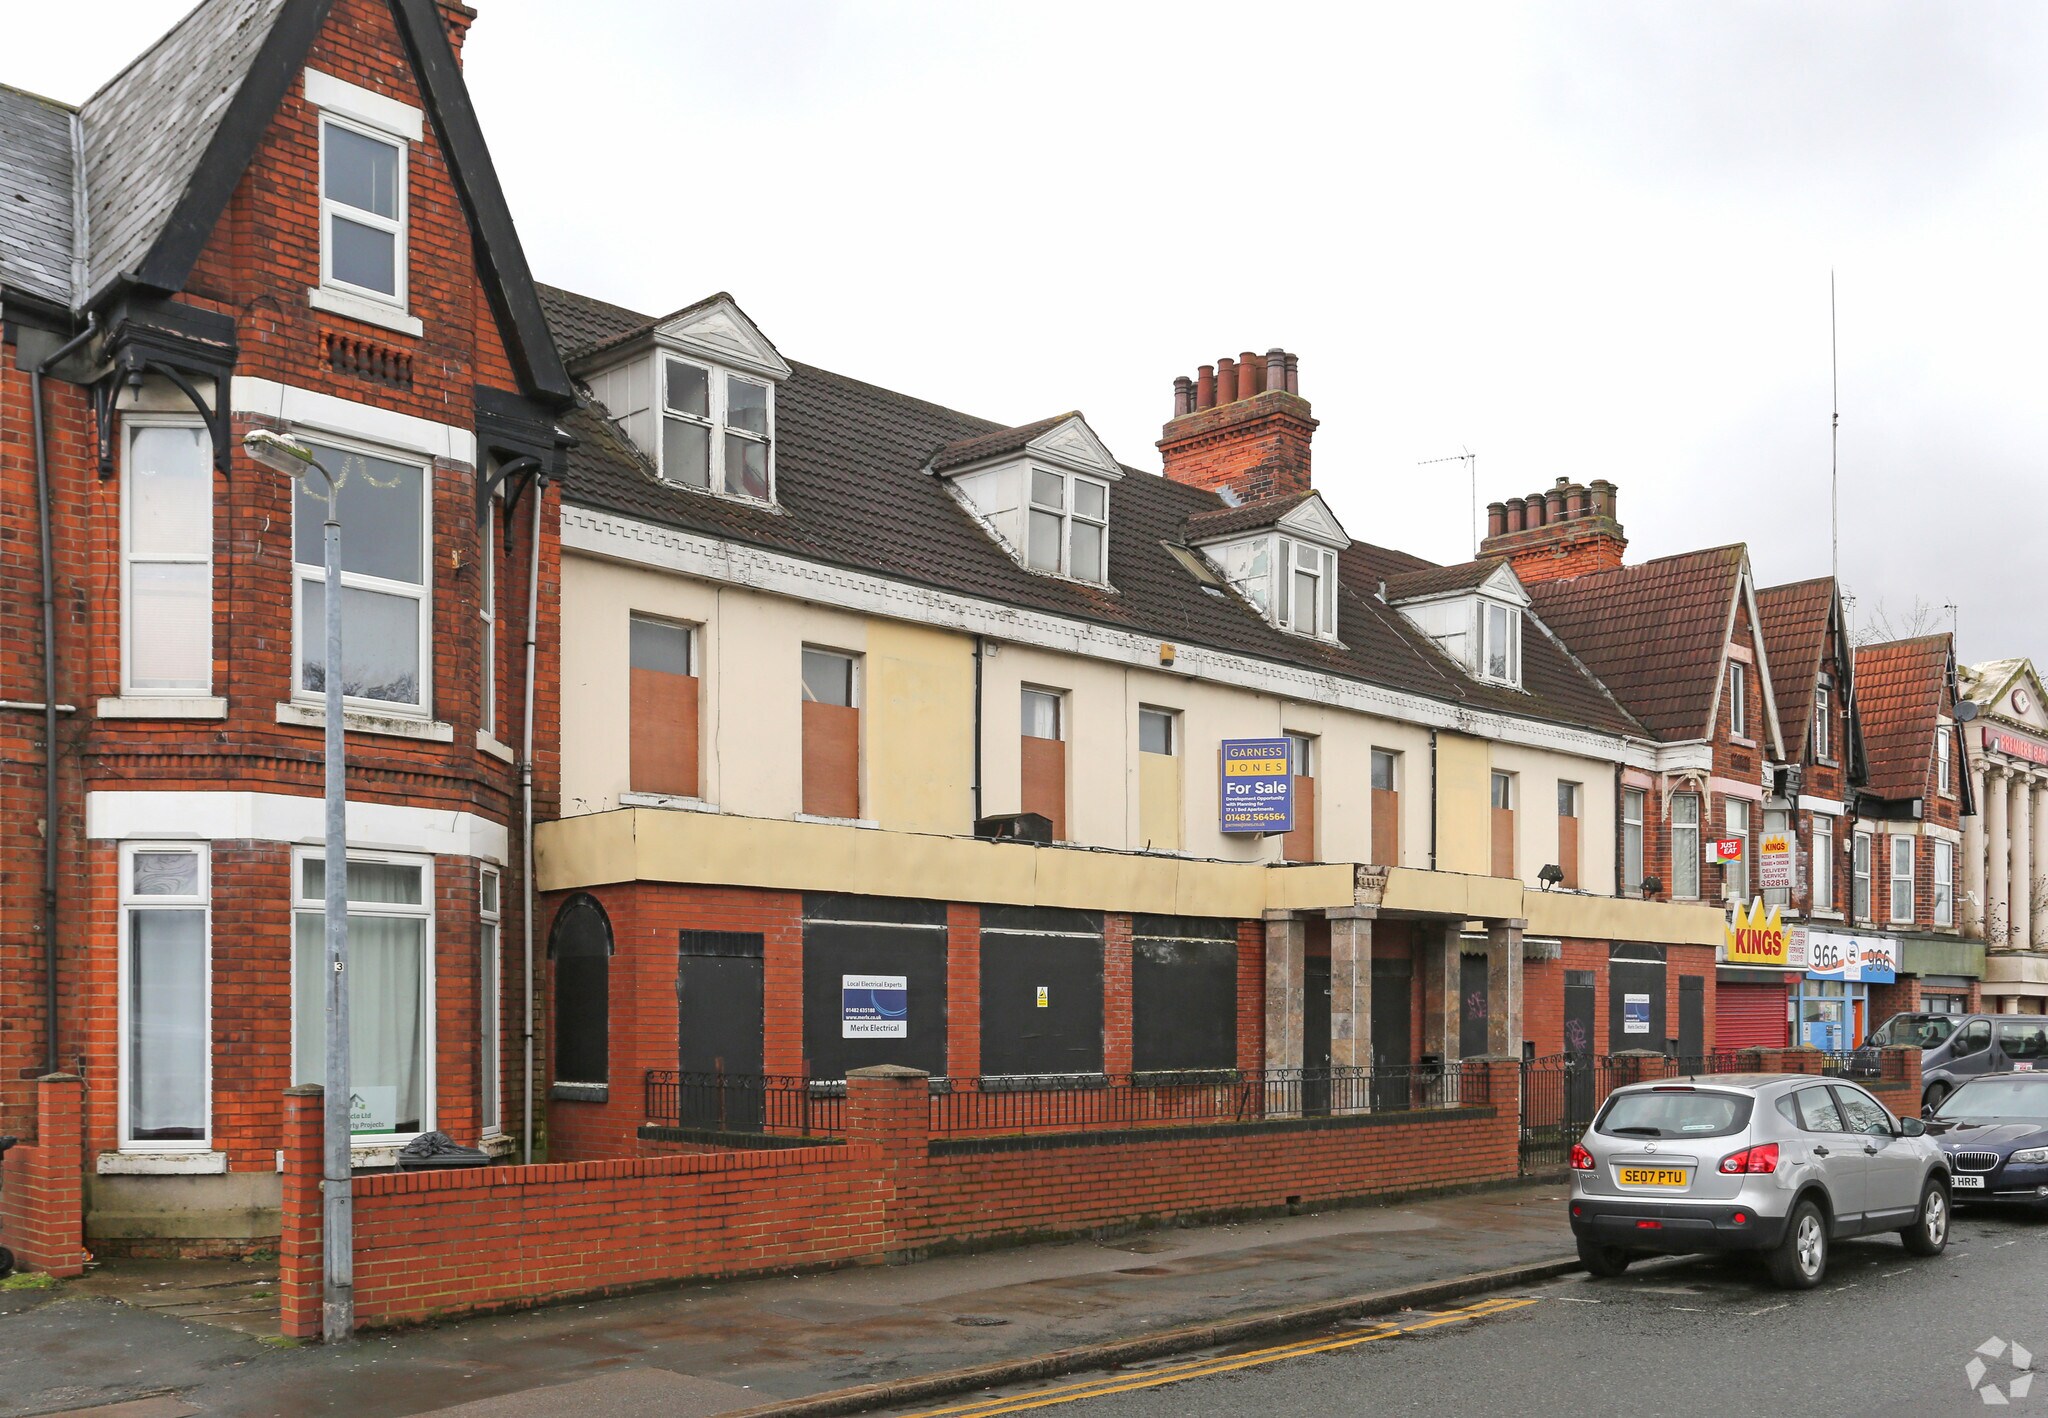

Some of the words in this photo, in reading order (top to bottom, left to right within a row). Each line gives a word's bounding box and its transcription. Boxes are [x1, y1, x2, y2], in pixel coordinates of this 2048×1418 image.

[1230, 748, 1282, 757] GARNESS
[2001, 735, 2032, 758] PREMIERE
[2033, 745, 2047, 764] BAR
[1230, 762, 1282, 772] JONES
[1227, 783, 1251, 794] For
[1255, 781, 1287, 794] Sale
[1225, 813, 1251, 821] 01482
[1720, 841, 1738, 850] JUST
[1765, 842, 1786, 851] KINGS
[1723, 847, 1738, 855] EAT
[1761, 879, 1789, 887] 352818
[1735, 928, 1782, 957] KINGS
[1813, 944, 1838, 969] 966
[1867, 948, 1890, 972] 966
[336, 962, 343, 971] 3
[870, 1024, 900, 1032] Electrical
[360, 1121, 385, 1129] Projects
[1625, 1170, 1655, 1182] SE07
[1658, 1171, 1682, 1183] PTU
[1957, 1177, 1978, 1186] HRR
